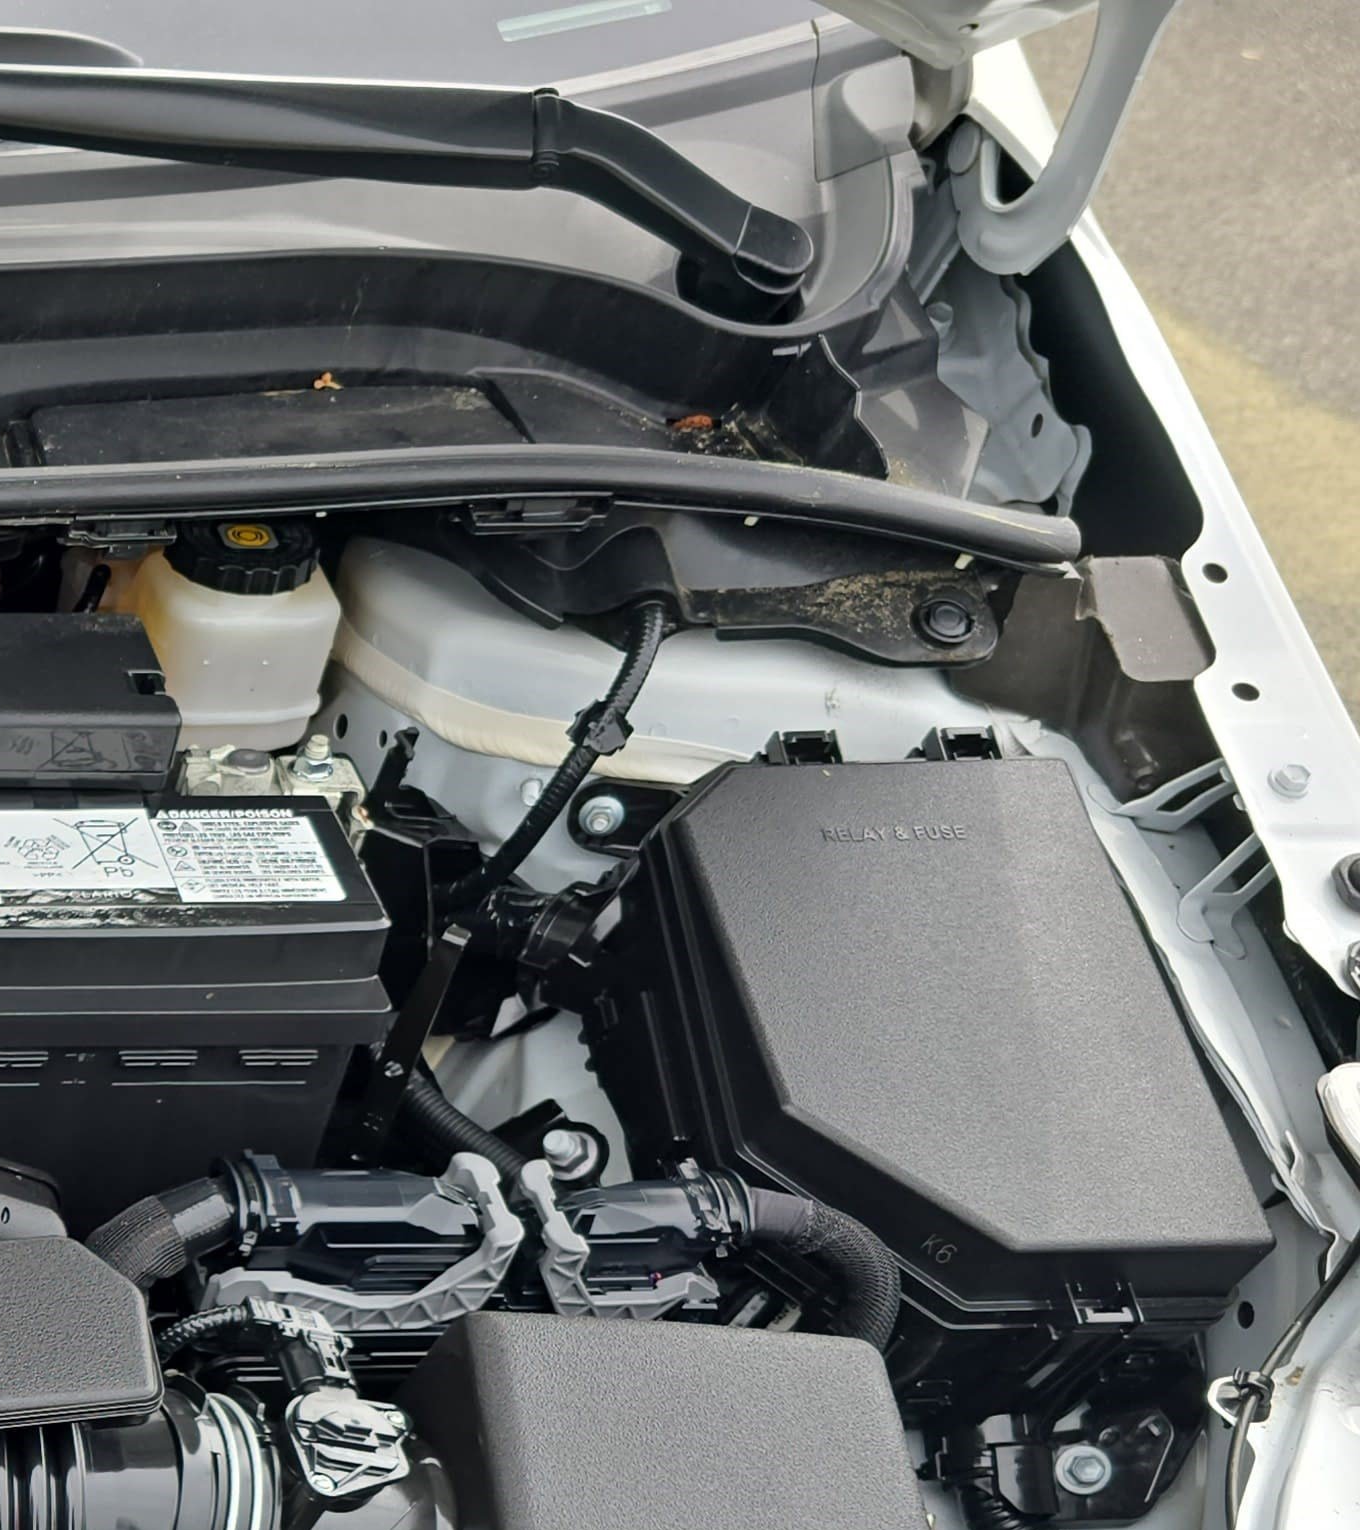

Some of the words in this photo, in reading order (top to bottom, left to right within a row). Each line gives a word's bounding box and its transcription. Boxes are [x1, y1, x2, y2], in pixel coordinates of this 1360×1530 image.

[168, 809, 294, 819] DANGER/POISON
[821, 825, 886, 842] RELAY
[893, 825, 911, 842] &
[913, 824, 968, 841] FUSE
[103, 866, 135, 878] Pb
